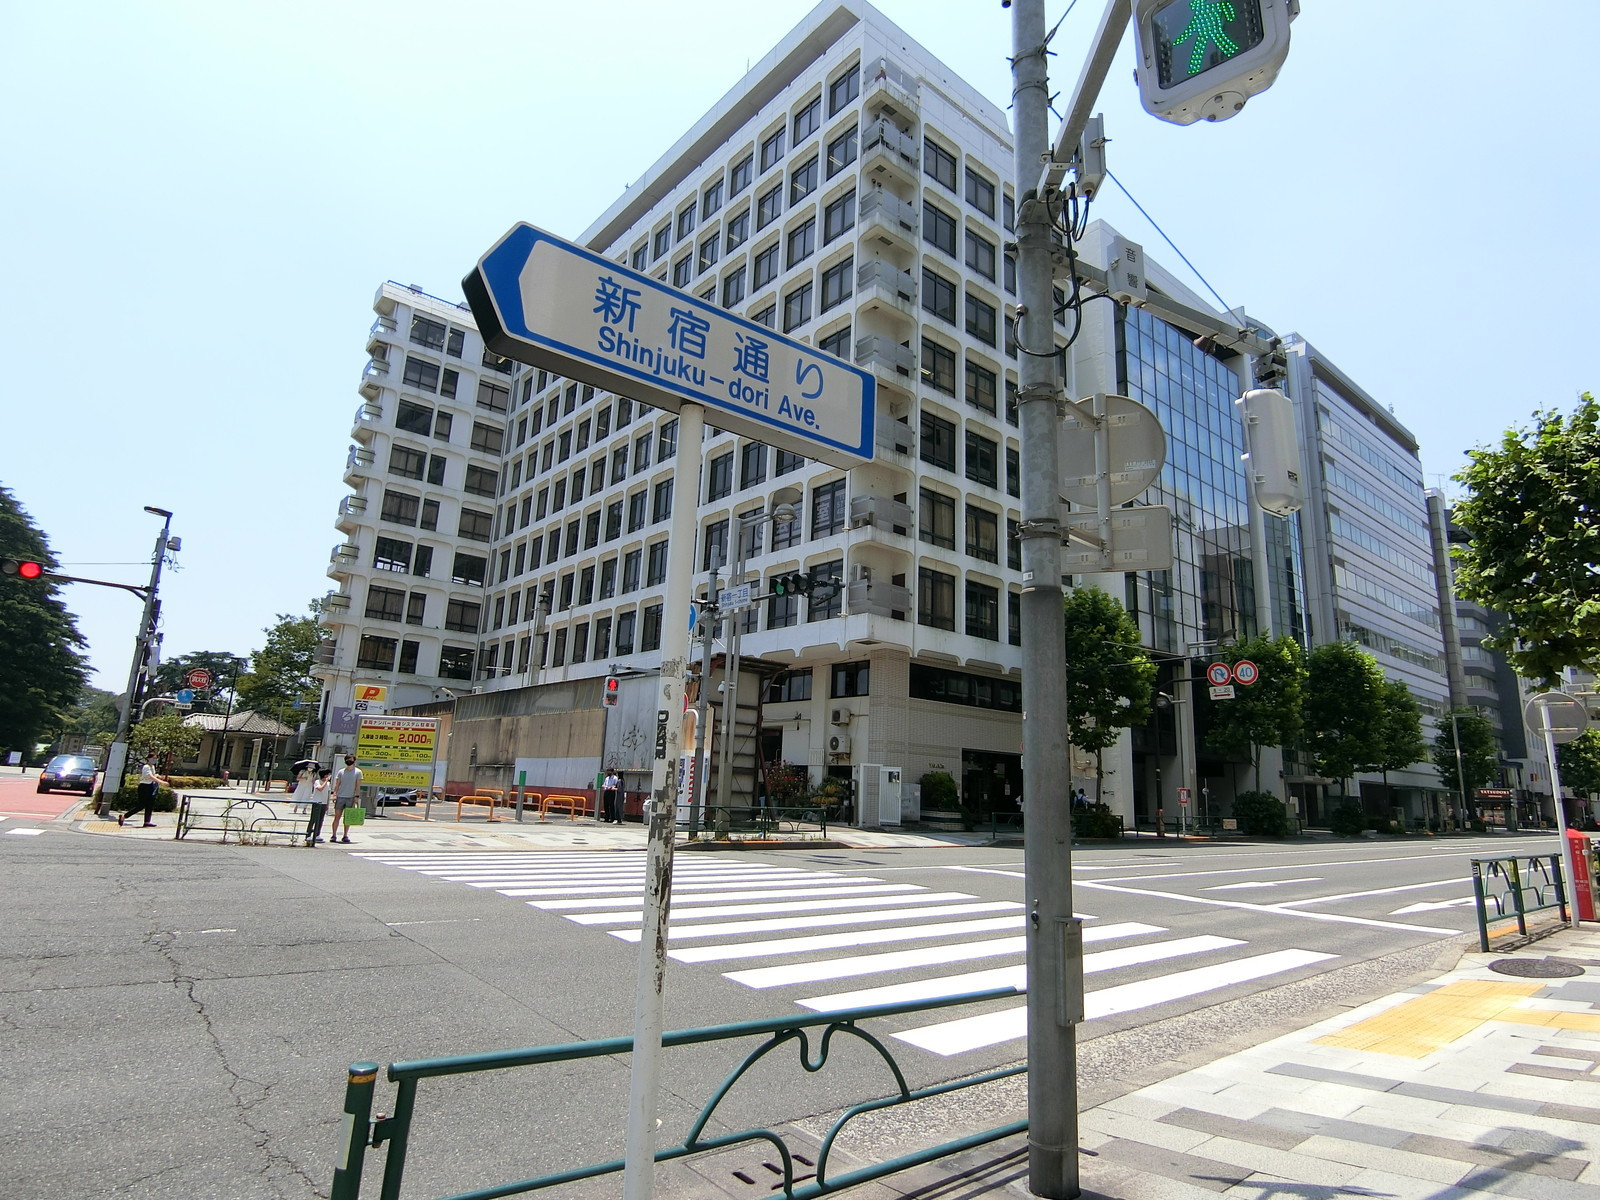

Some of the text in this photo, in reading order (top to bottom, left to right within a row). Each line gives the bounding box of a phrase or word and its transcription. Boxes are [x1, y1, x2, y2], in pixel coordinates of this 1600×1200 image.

[1125, 247, 1138, 289] 音響
[593, 276, 824, 400] 新宿通り
[777, 394, 821, 431] Ave.
[720, 587, 749, 602] 新宿一丁目
[1239, 666, 1253, 678] 40
[362, 686, 380, 699] P
